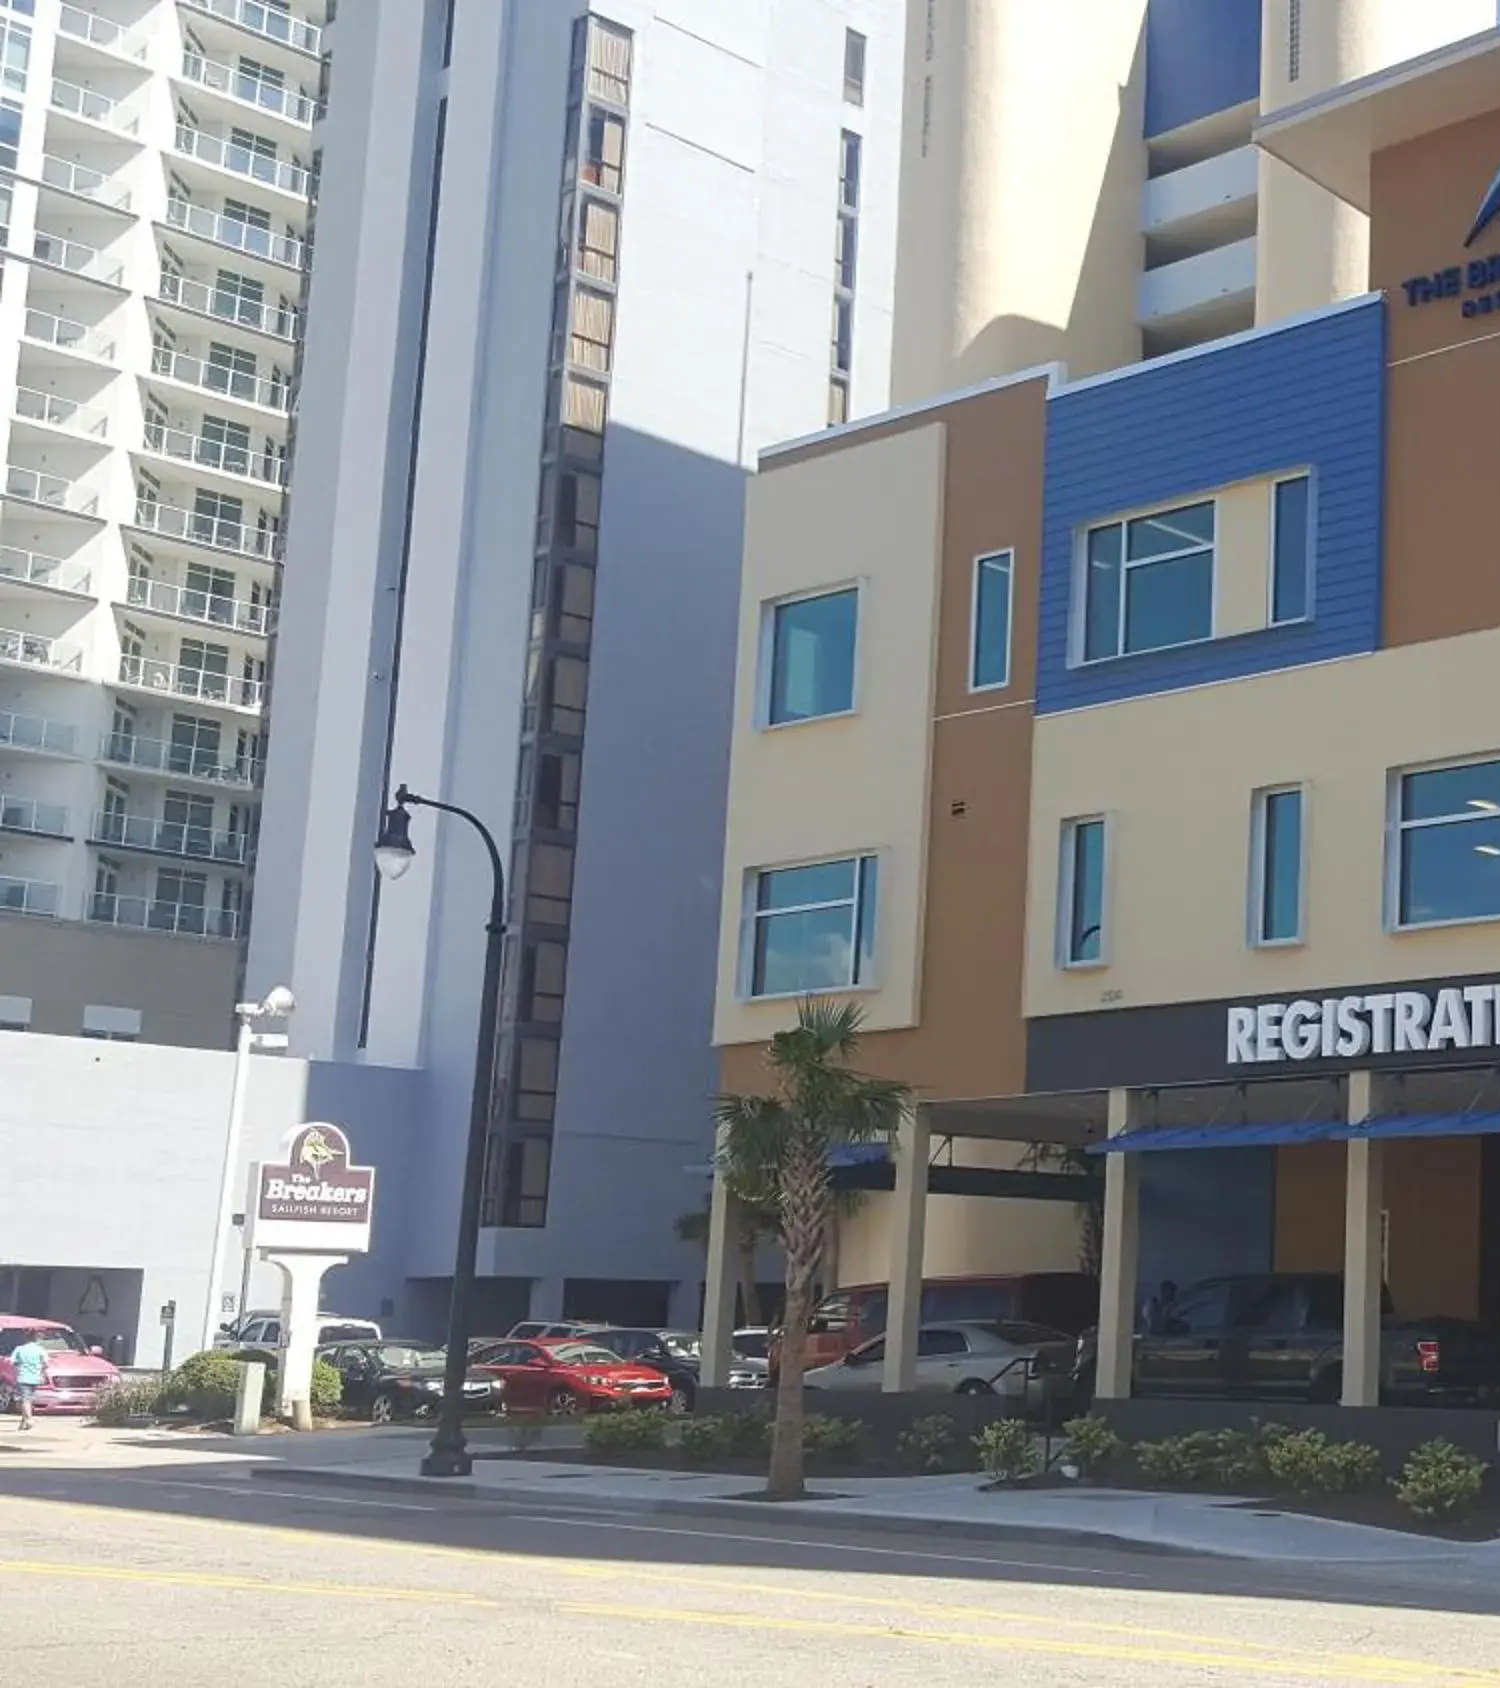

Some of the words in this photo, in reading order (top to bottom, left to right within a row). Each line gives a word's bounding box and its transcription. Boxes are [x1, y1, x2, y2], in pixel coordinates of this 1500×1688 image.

[1402, 266, 1460, 306] THE
[291, 1173, 311, 1183] The
[265, 1178, 367, 1203] Breakers
[271, 1203, 317, 1215] SAILFISH
[320, 1207, 359, 1216] RESORT
